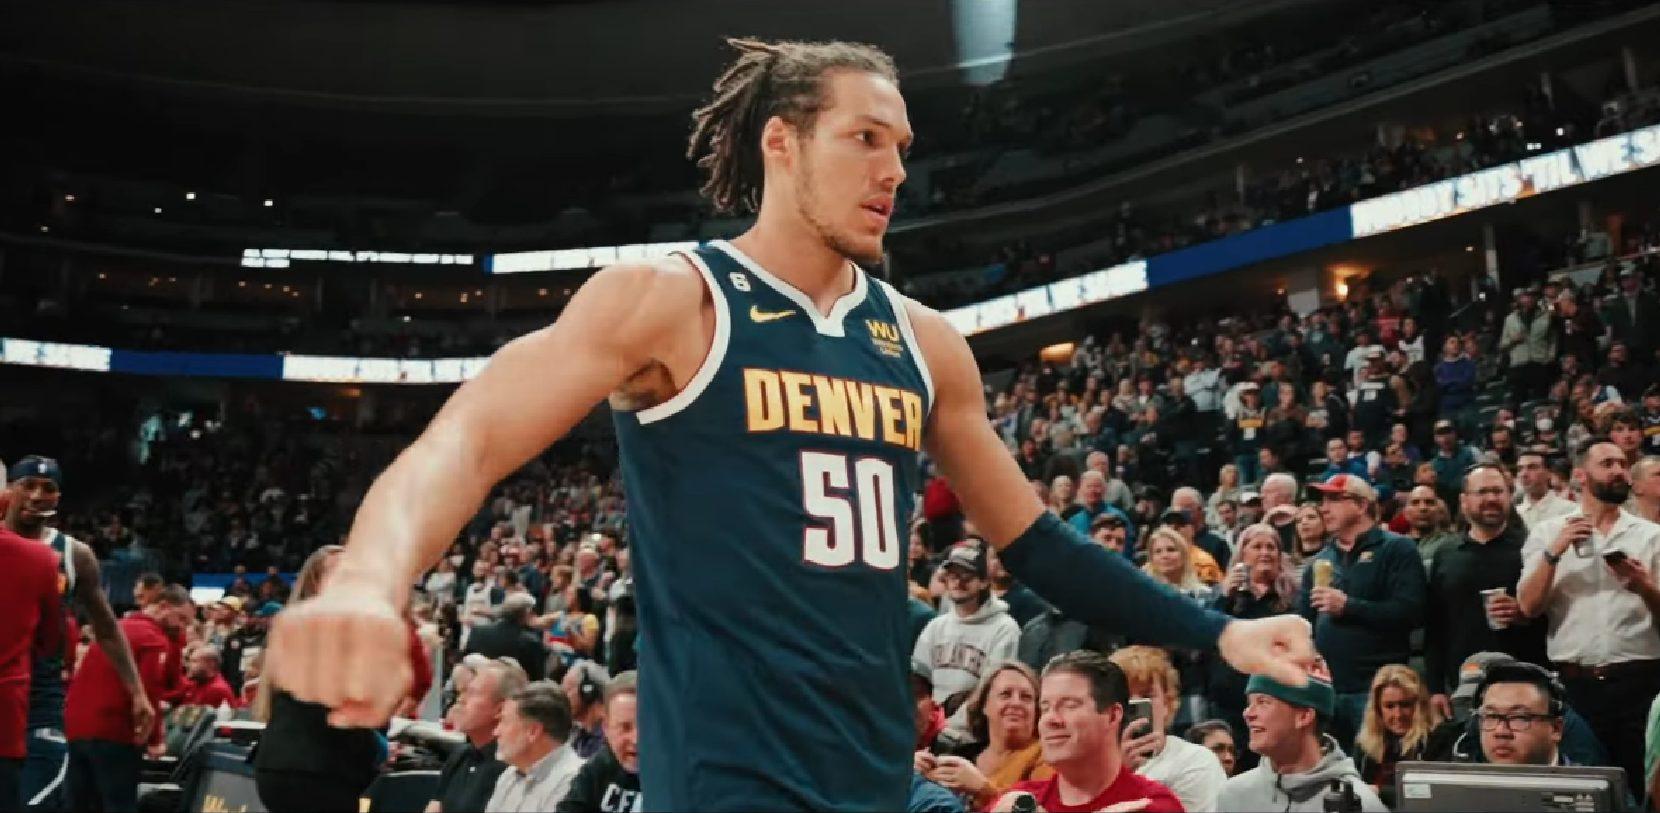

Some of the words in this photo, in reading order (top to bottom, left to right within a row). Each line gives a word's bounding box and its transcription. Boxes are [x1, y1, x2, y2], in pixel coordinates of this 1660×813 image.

[864, 319, 900, 342] WU
[743, 367, 922, 451] DENVER
[800, 450, 900, 570] 50
